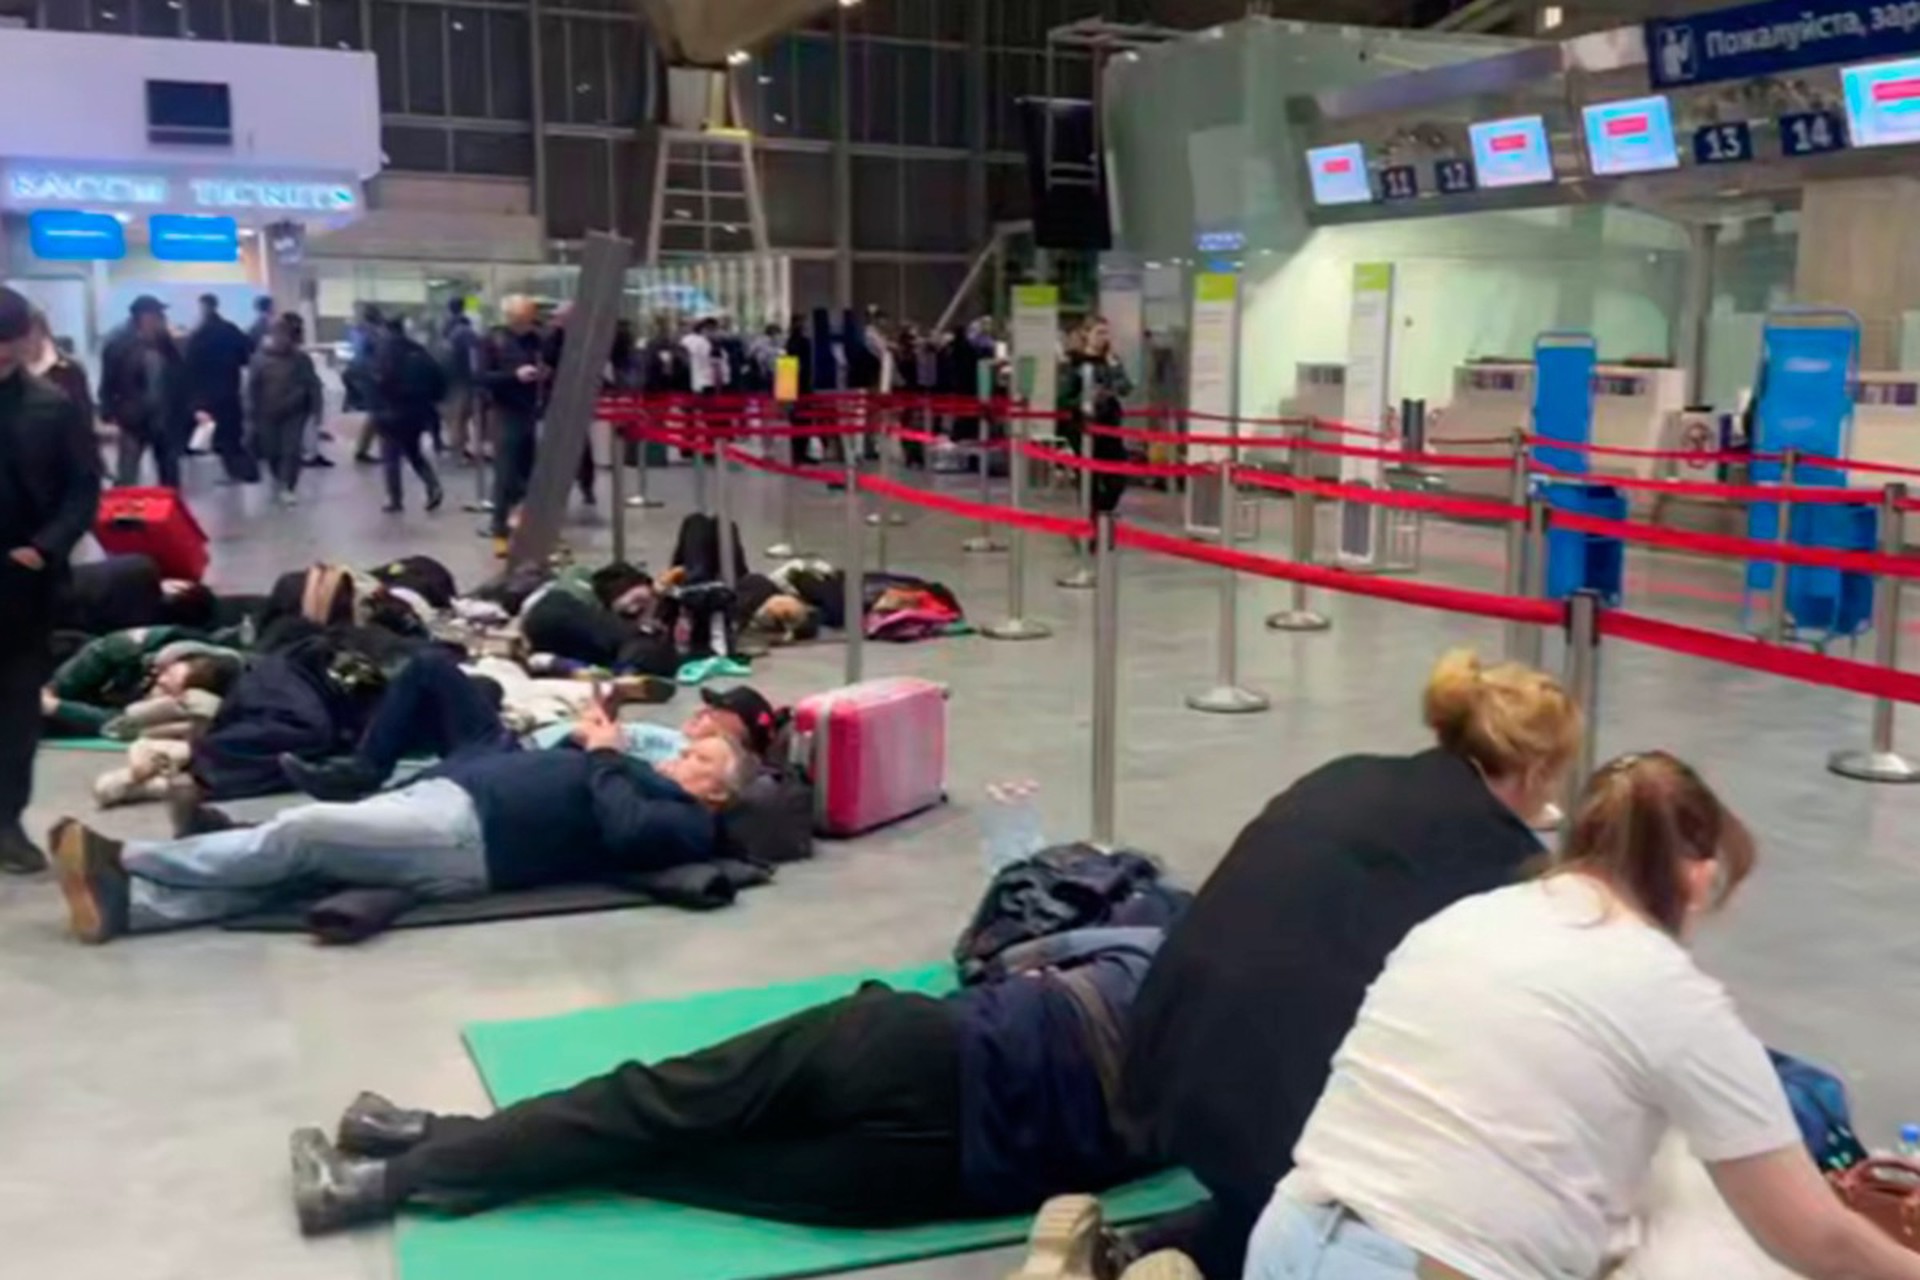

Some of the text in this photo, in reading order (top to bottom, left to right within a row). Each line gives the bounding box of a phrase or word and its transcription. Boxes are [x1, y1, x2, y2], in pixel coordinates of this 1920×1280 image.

[1706, 11, 1867, 58] Пожалуйста,
[1706, 126, 1741, 160] 13
[1792, 115, 1832, 151] 14
[1387, 170, 1412, 195] 11
[1443, 162, 1469, 190] 12
